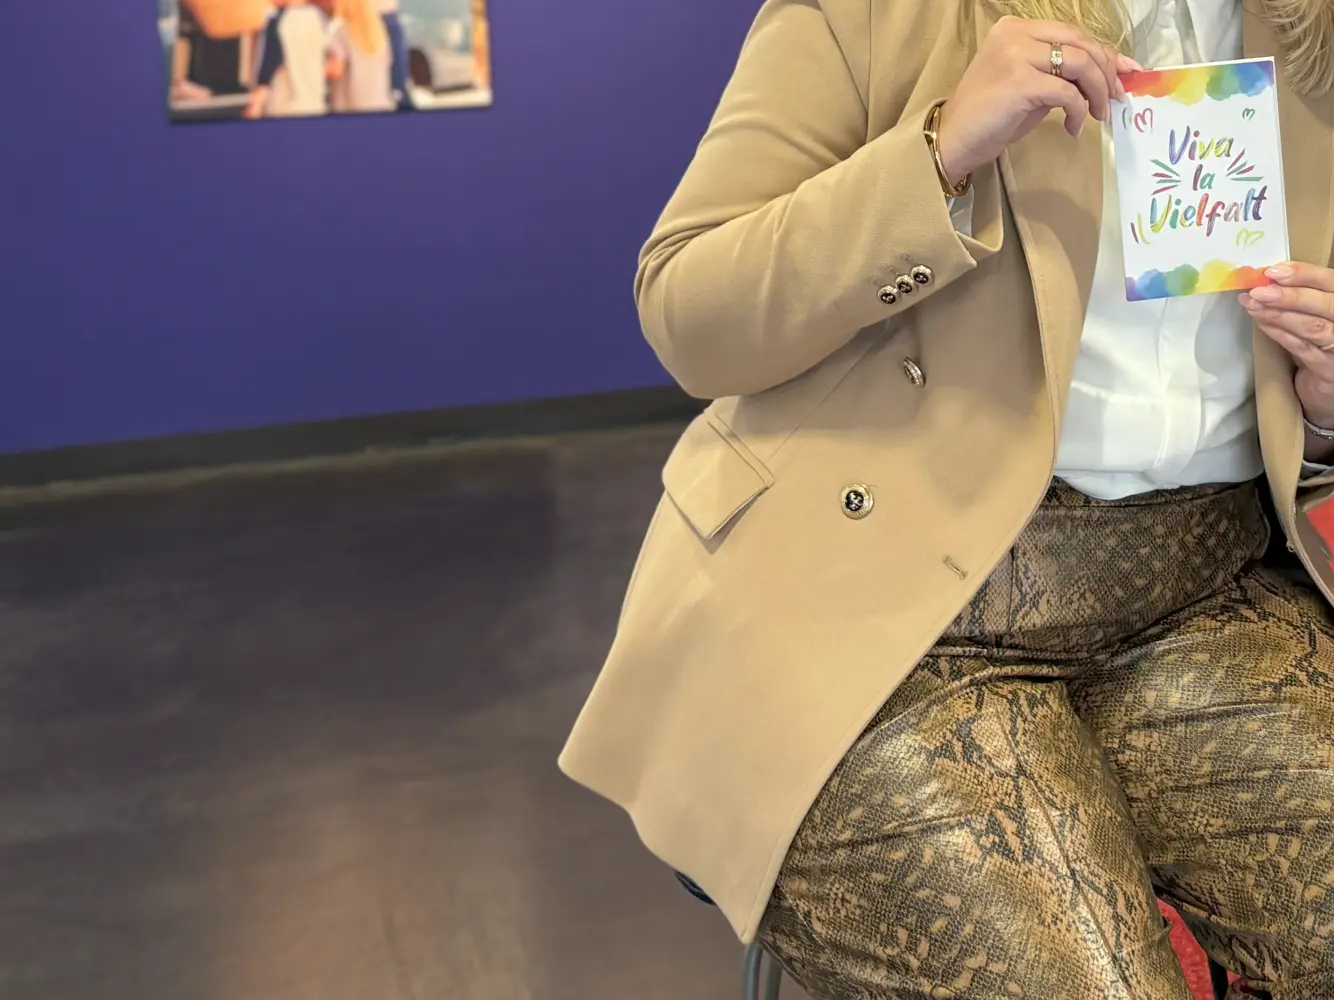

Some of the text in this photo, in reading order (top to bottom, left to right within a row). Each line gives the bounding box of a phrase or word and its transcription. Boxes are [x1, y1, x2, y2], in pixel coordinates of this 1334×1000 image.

[1169, 125, 1234, 165] Viva
[1192, 164, 1216, 191] la
[1149, 185, 1268, 237] Vielfalt
